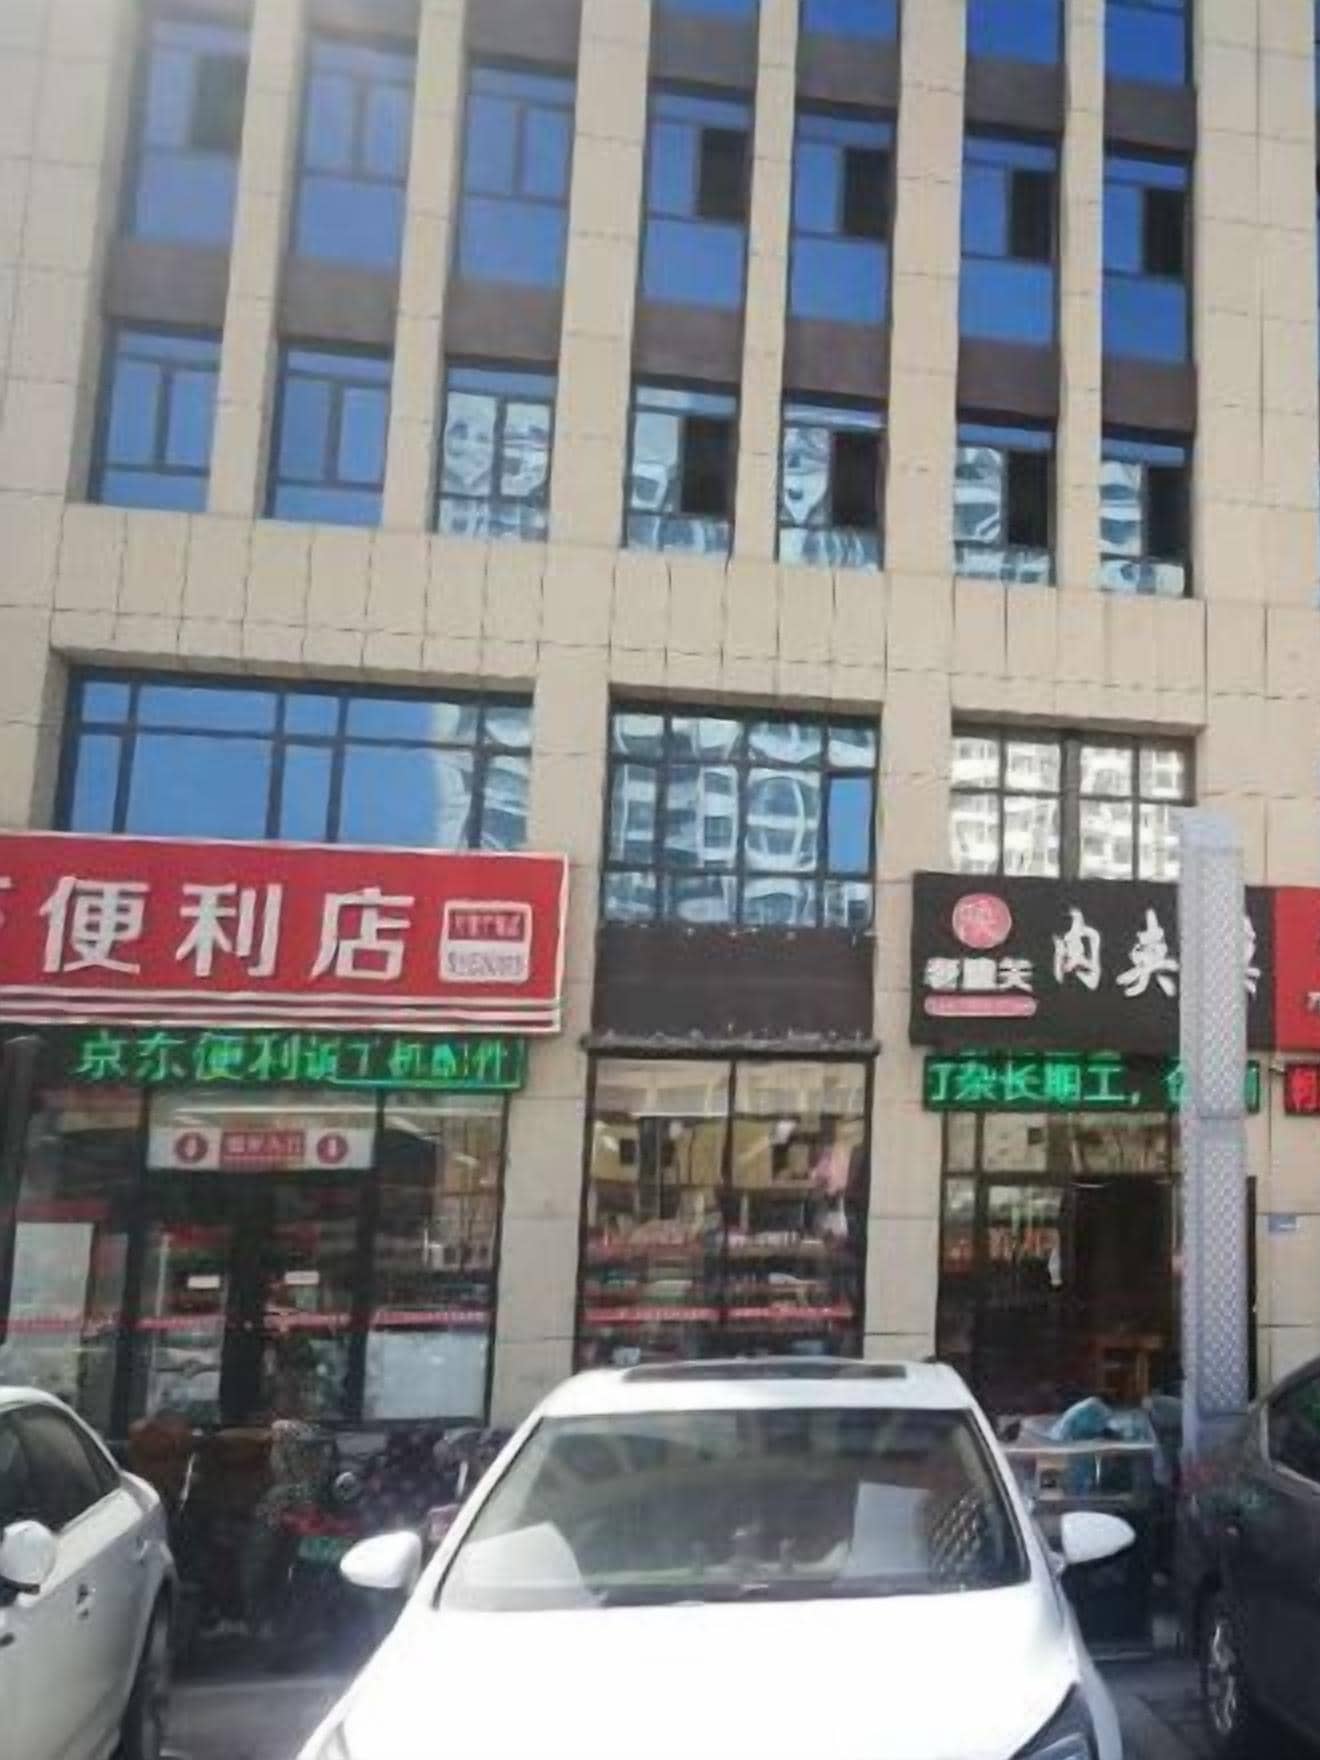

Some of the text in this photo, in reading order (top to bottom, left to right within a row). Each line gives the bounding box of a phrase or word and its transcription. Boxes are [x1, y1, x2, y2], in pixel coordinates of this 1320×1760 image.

[0, 874, 416, 981] 便利店
[1053, 908, 1262, 998] 肉夹
